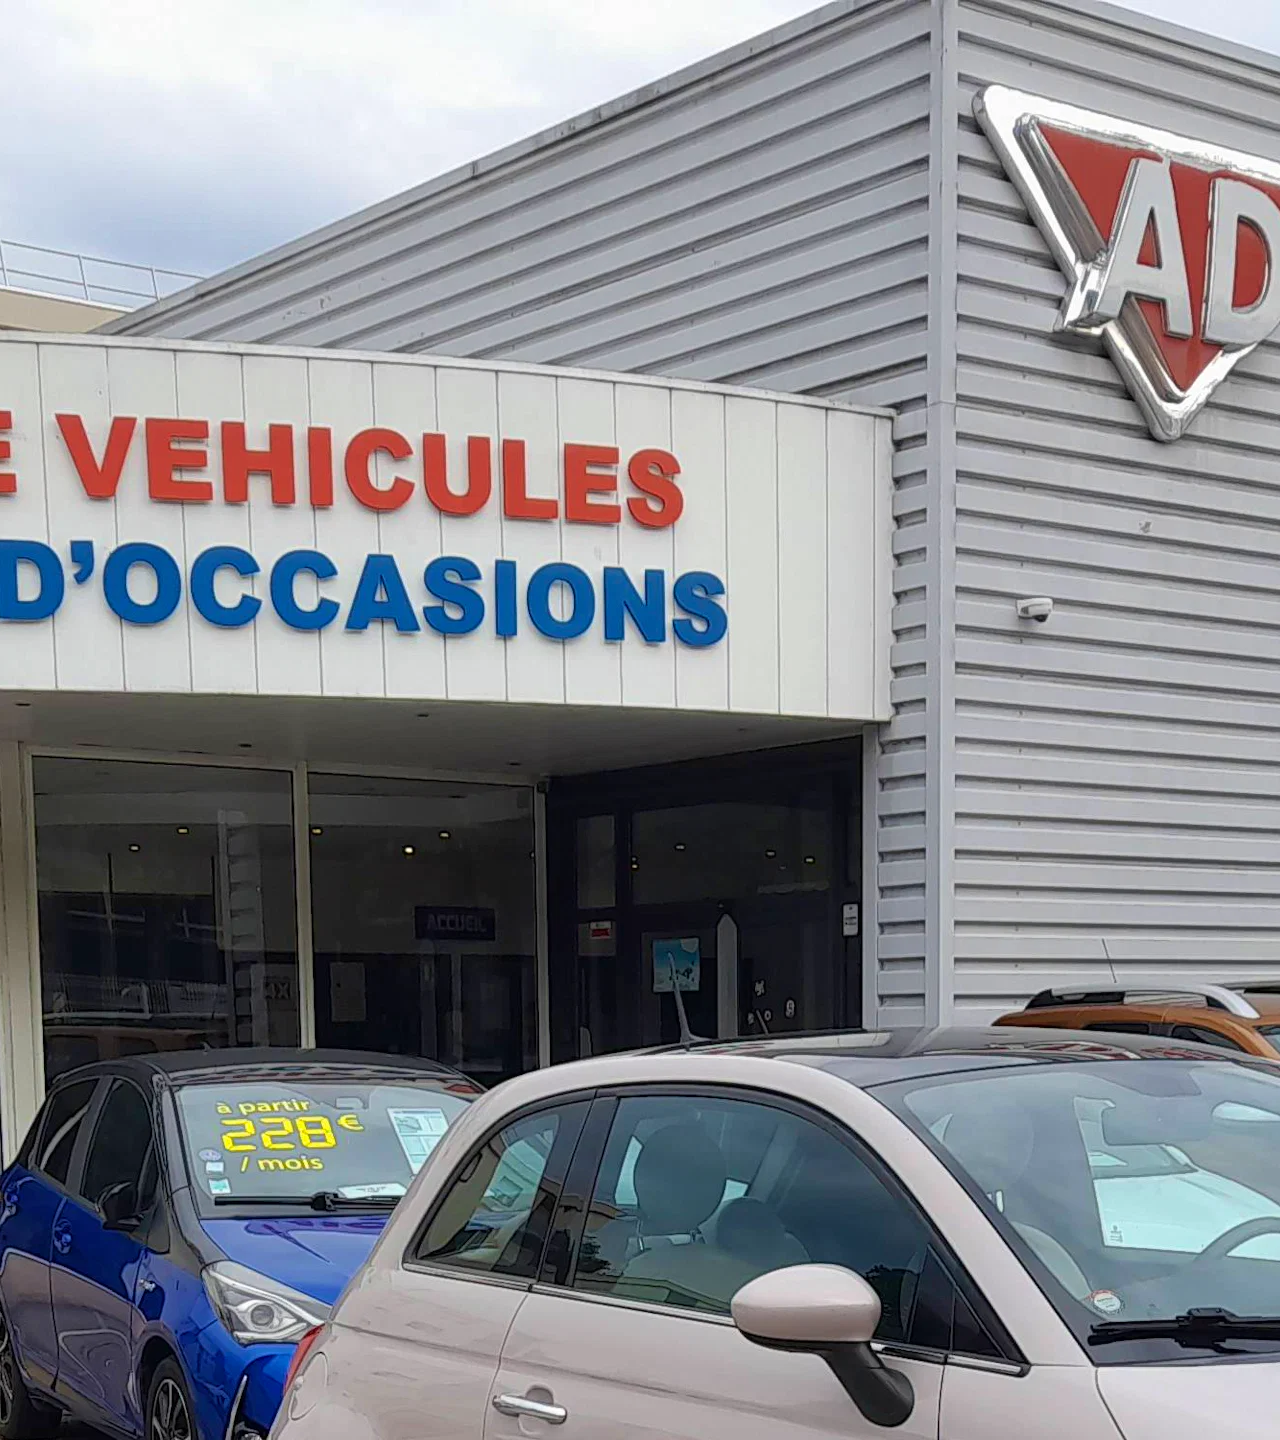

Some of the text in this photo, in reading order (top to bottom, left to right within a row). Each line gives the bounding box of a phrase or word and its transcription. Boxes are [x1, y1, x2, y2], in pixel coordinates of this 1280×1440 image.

[56, 412, 685, 529] VEHICULES
[216, 1097, 310, 1116] à partir
[257, 1154, 324, 1171] mois
